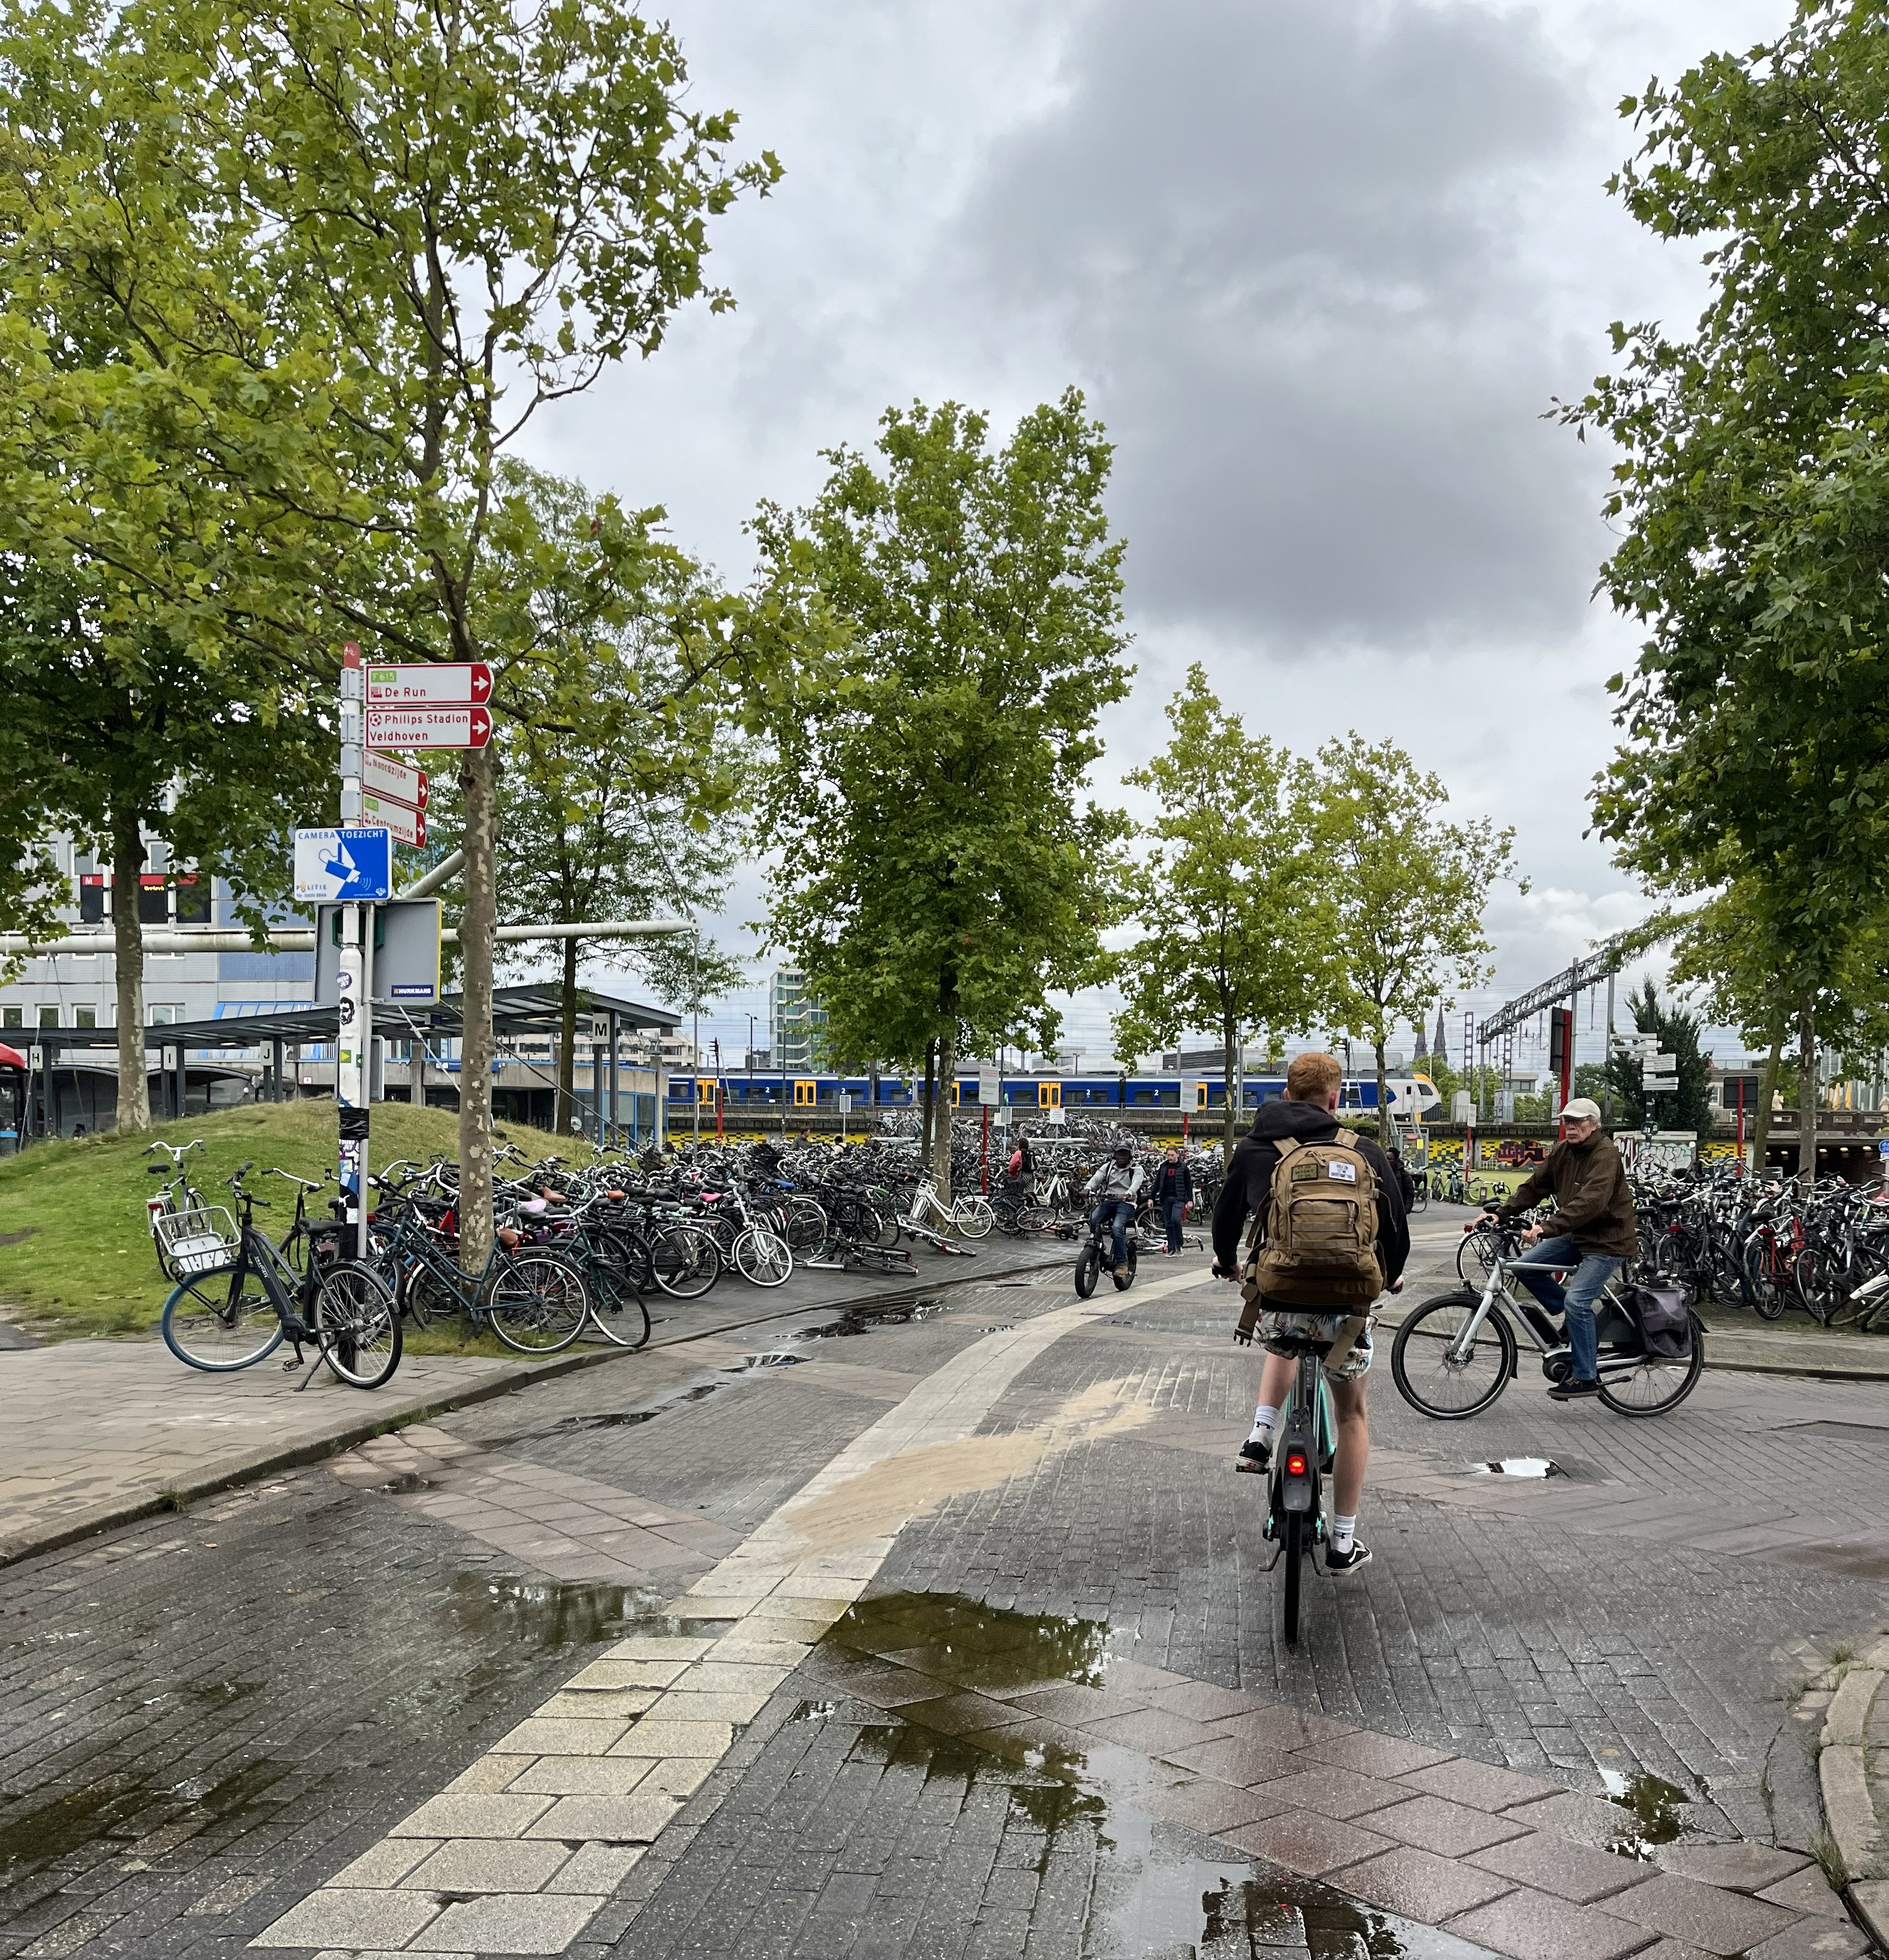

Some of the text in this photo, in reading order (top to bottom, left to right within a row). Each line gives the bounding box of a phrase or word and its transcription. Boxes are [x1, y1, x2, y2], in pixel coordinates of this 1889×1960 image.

[385, 687, 426, 697] De Run
[385, 714, 469, 725] Philips Stadion
[370, 731, 428, 741] Veldhoven
[372, 759, 407, 779] Noordzijde
[299, 830, 384, 840] CAMERA TOEZICHT
[595, 1023, 607, 1037] M
[32, 1053, 39, 1063] H
[263, 1048, 270, 1059] J
